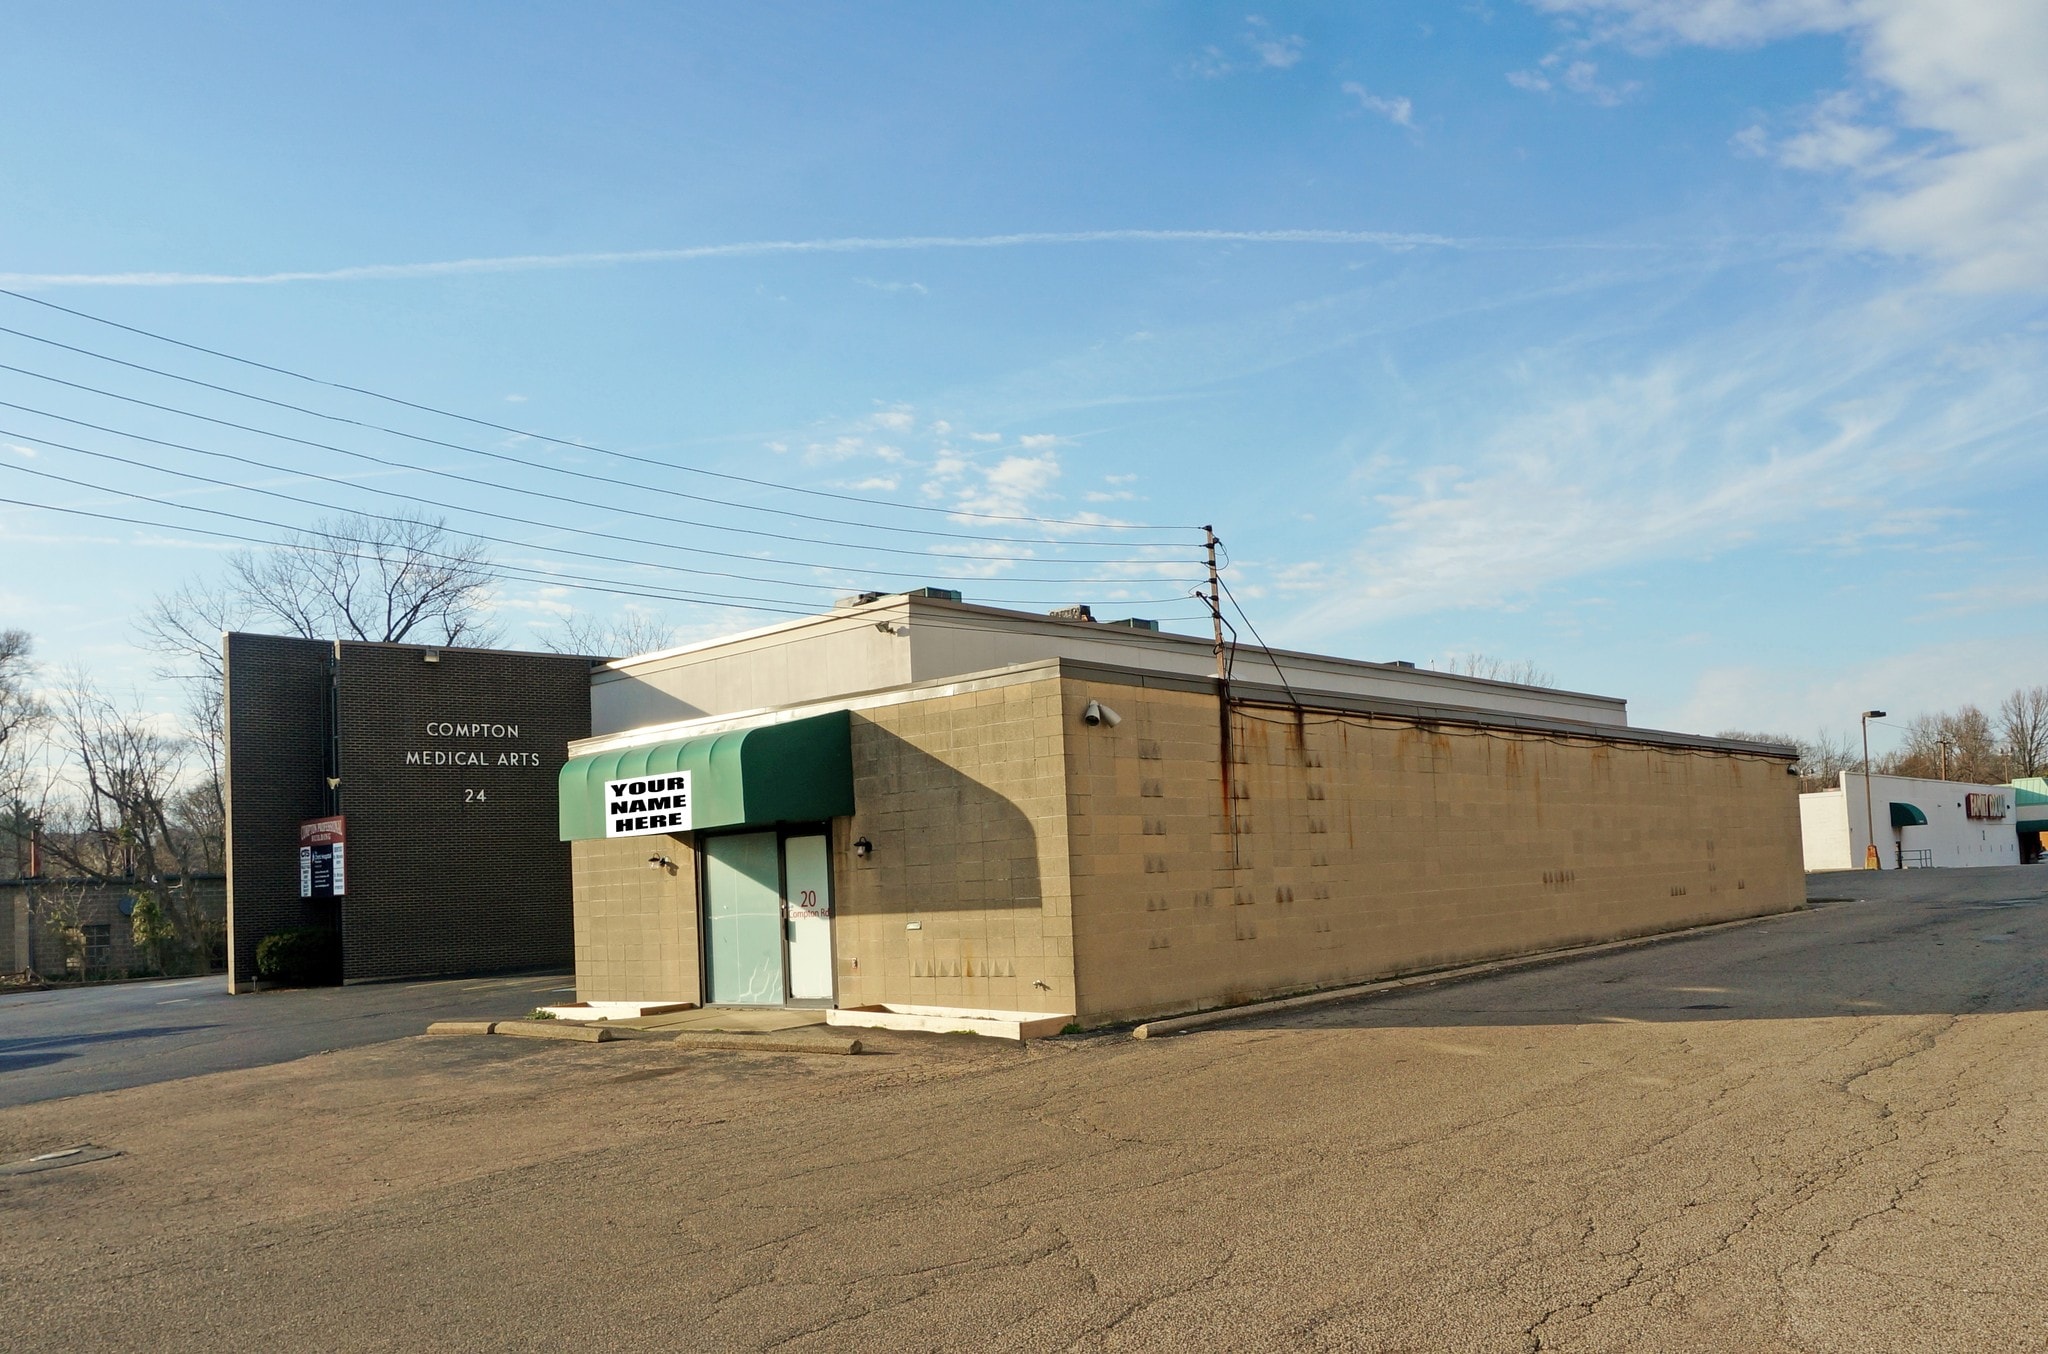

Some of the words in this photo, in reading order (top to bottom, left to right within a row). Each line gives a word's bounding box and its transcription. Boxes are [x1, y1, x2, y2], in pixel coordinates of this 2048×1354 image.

[426, 722, 519, 738] COMPTON
[406, 751, 490, 766] MEDICAL
[497, 752, 540, 767] ARTS
[611, 777, 685, 797] YOUR
[464, 789, 487, 803] 24
[611, 794, 686, 815] NAME
[616, 812, 682, 833] HERE
[801, 891, 816, 907] 20
[789, 910, 819, 919] Compton
